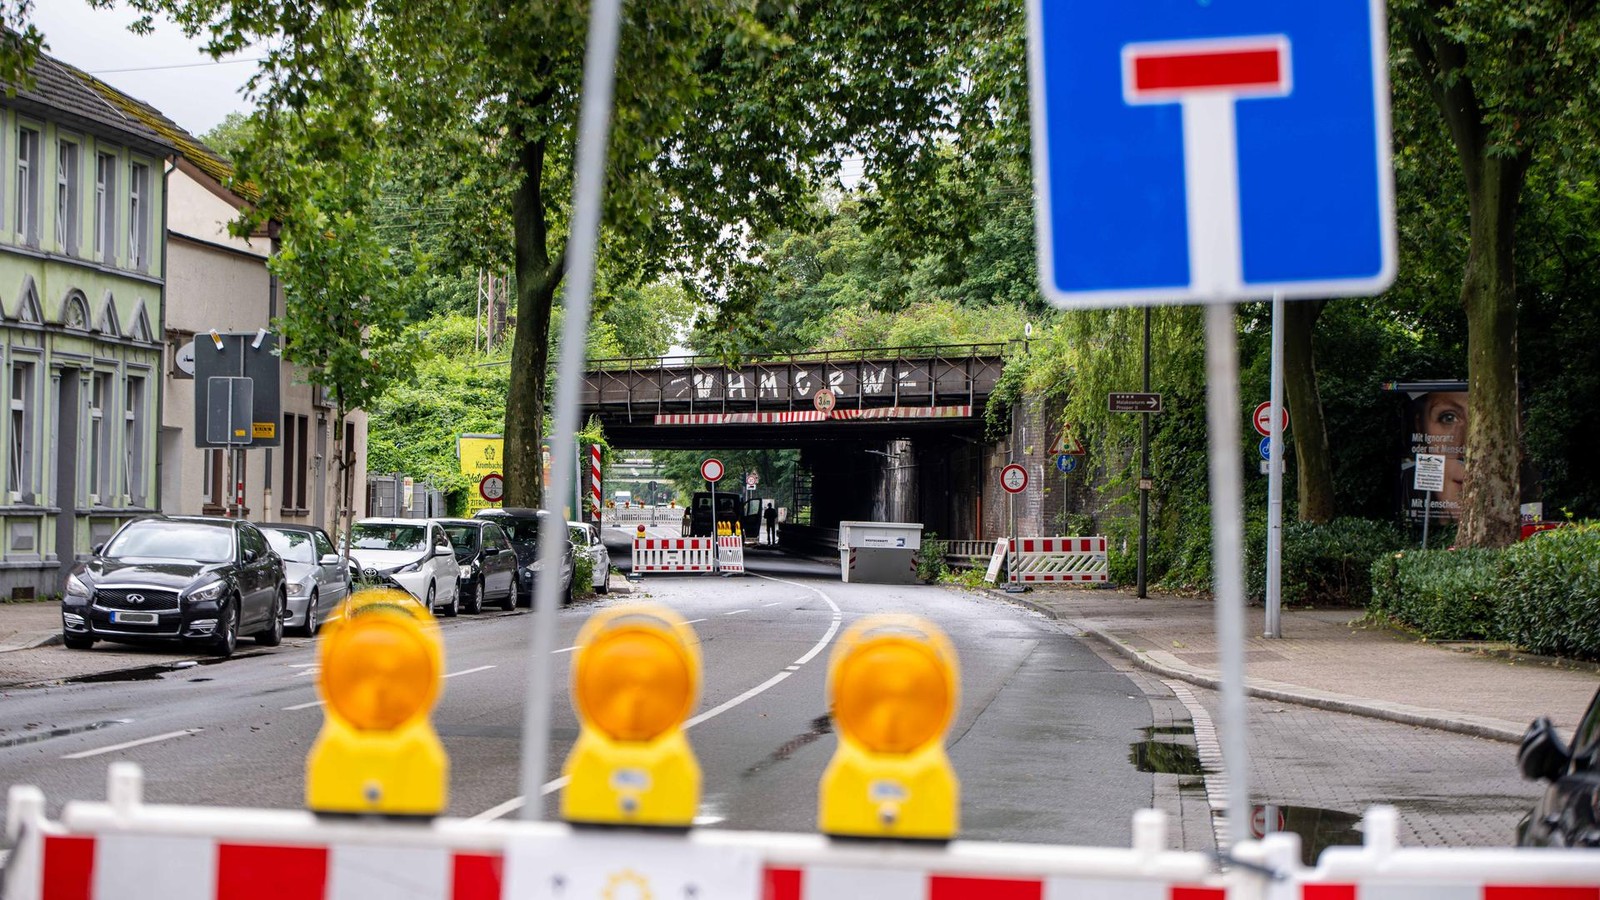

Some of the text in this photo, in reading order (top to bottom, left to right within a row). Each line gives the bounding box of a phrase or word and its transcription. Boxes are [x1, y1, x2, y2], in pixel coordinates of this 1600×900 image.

[1412, 433, 1454, 444] Mit Ignoranz
[1412, 444, 1466, 454] oder mit Mensch
[1411, 498, 1423, 508] Mit
